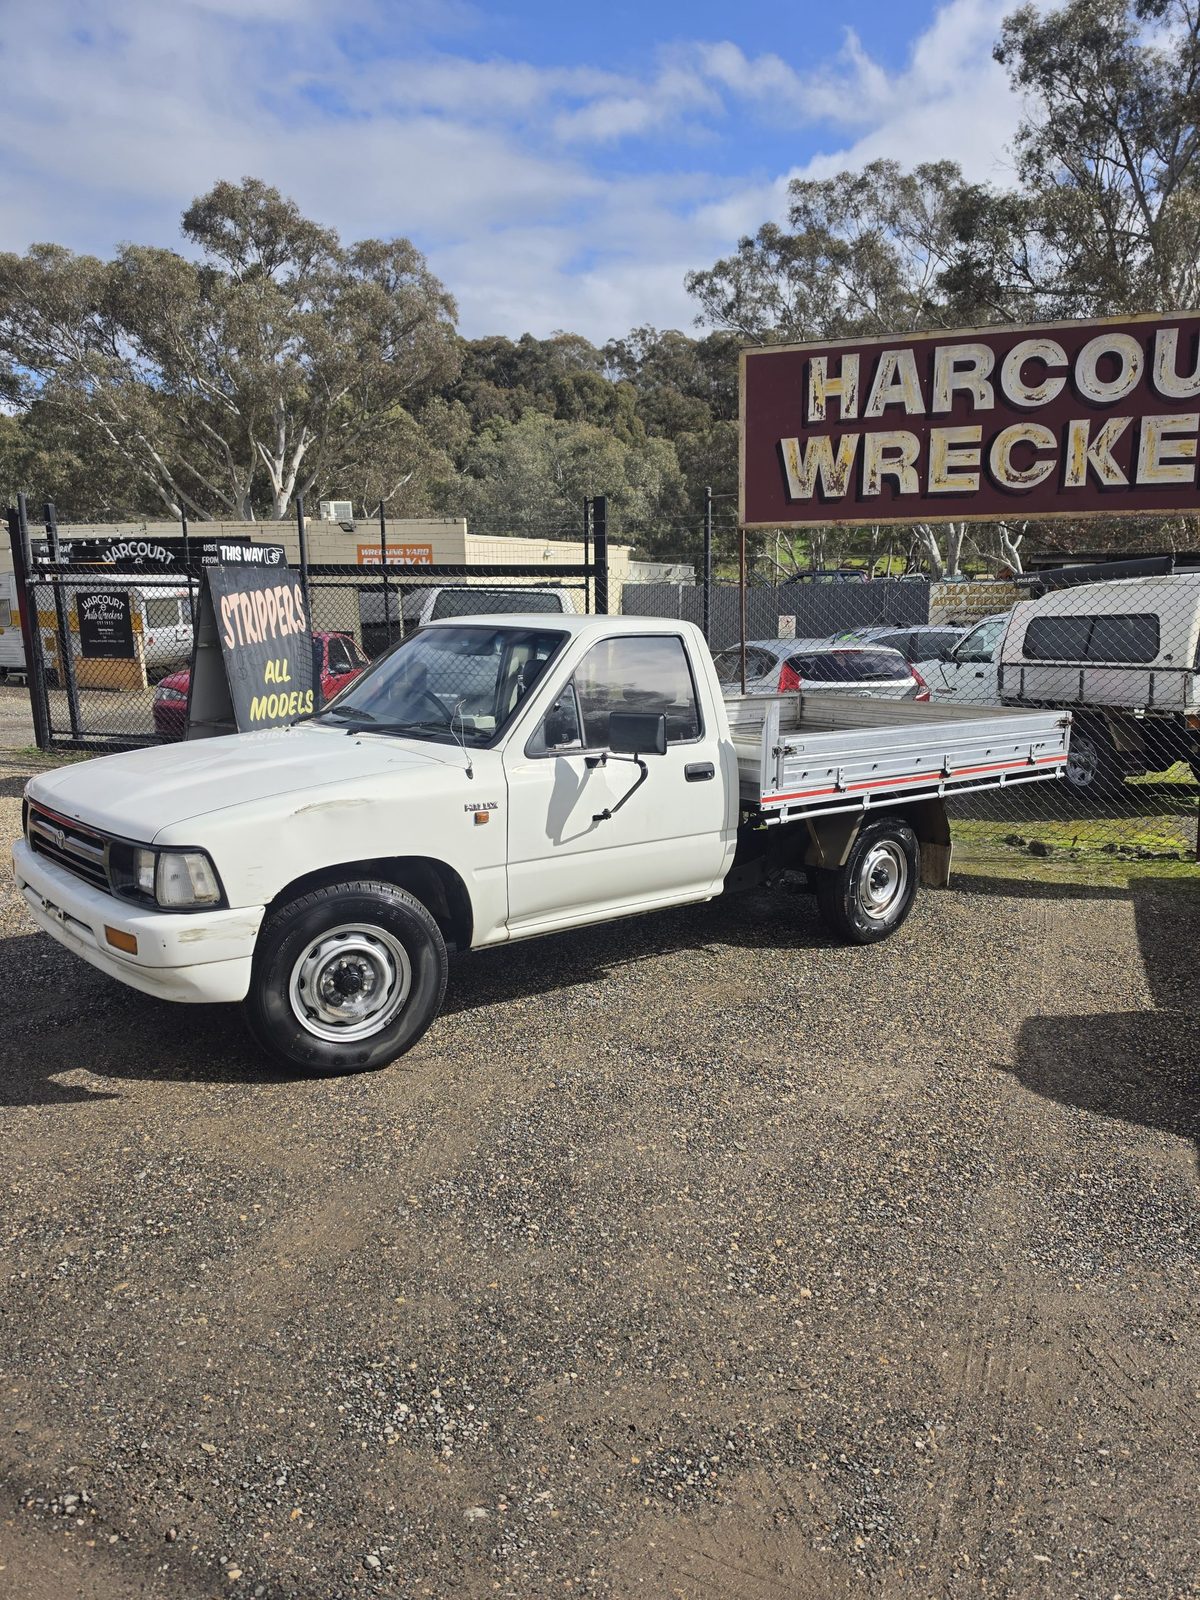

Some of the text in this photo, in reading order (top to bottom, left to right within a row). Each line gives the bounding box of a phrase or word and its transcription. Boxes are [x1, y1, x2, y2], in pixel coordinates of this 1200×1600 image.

[780, 412, 1199, 499] WRECKE
[101, 541, 175, 565] HARCOURT
[220, 545, 264, 562] THIS WAY
[406, 548, 430, 556] YARD
[81, 594, 125, 610] HARCOURT
[220, 583, 306, 650] STRIPPERS
[264, 658, 291, 684] ALL
[250, 689, 314, 722] MODELS
